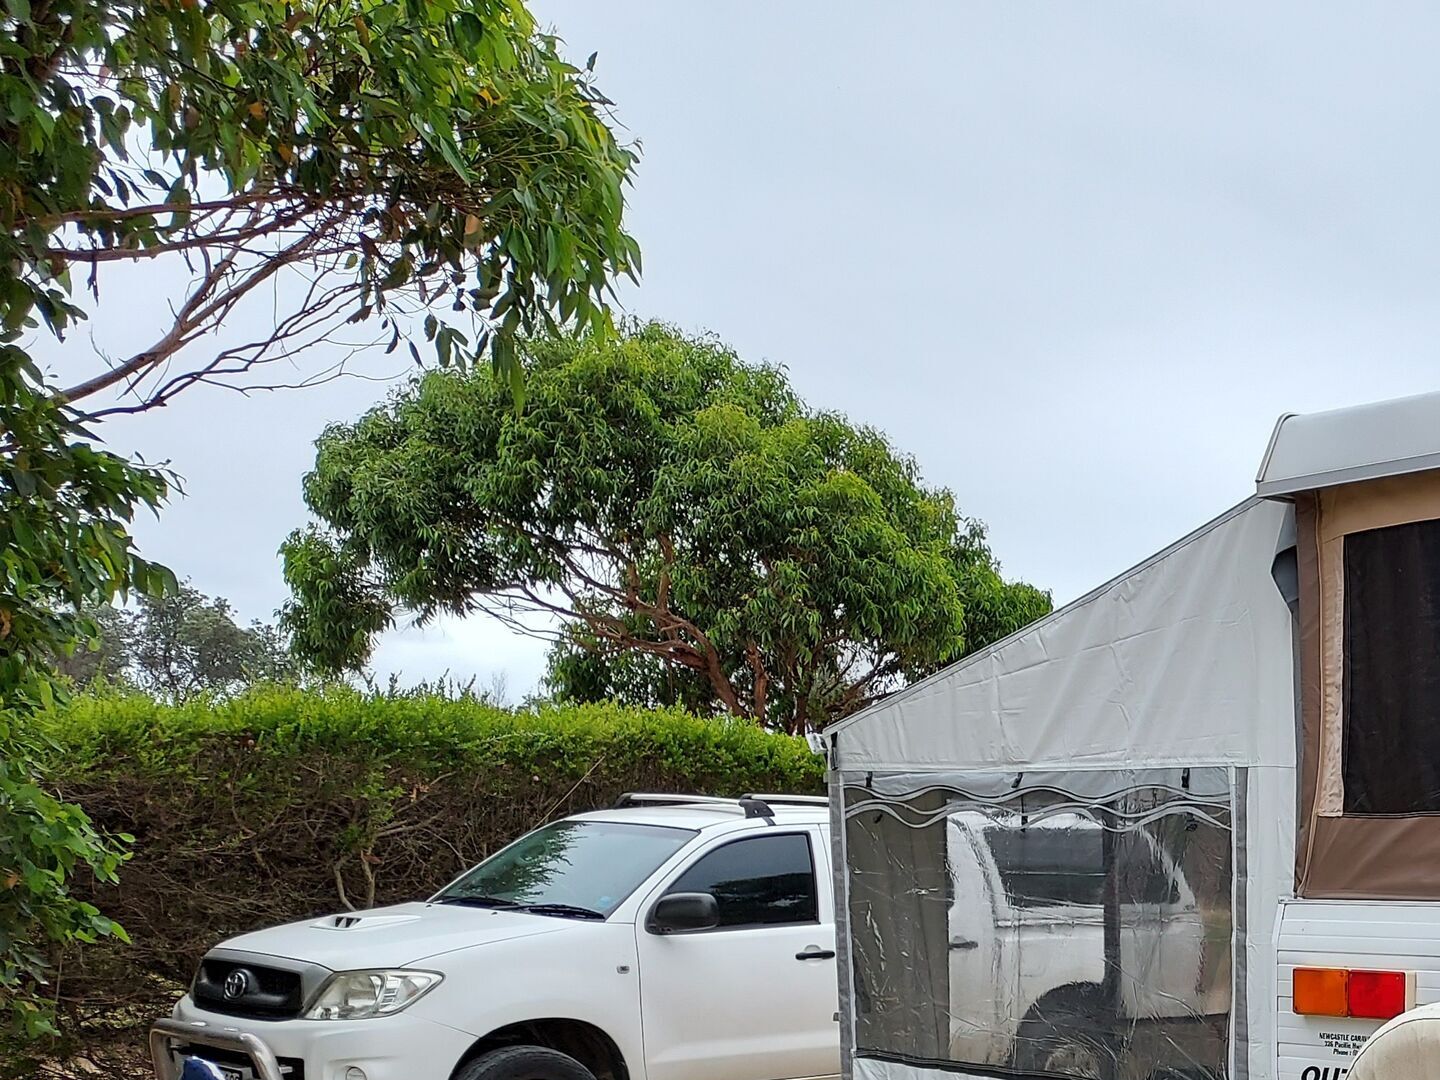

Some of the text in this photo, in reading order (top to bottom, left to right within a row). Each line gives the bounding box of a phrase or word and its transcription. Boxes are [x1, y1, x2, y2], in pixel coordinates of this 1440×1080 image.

[1319, 1032, 1350, 1041] NEWCASTLE
[1334, 1041, 1351, 1049] Pacific
[1333, 1048, 1348, 1056] Phone
